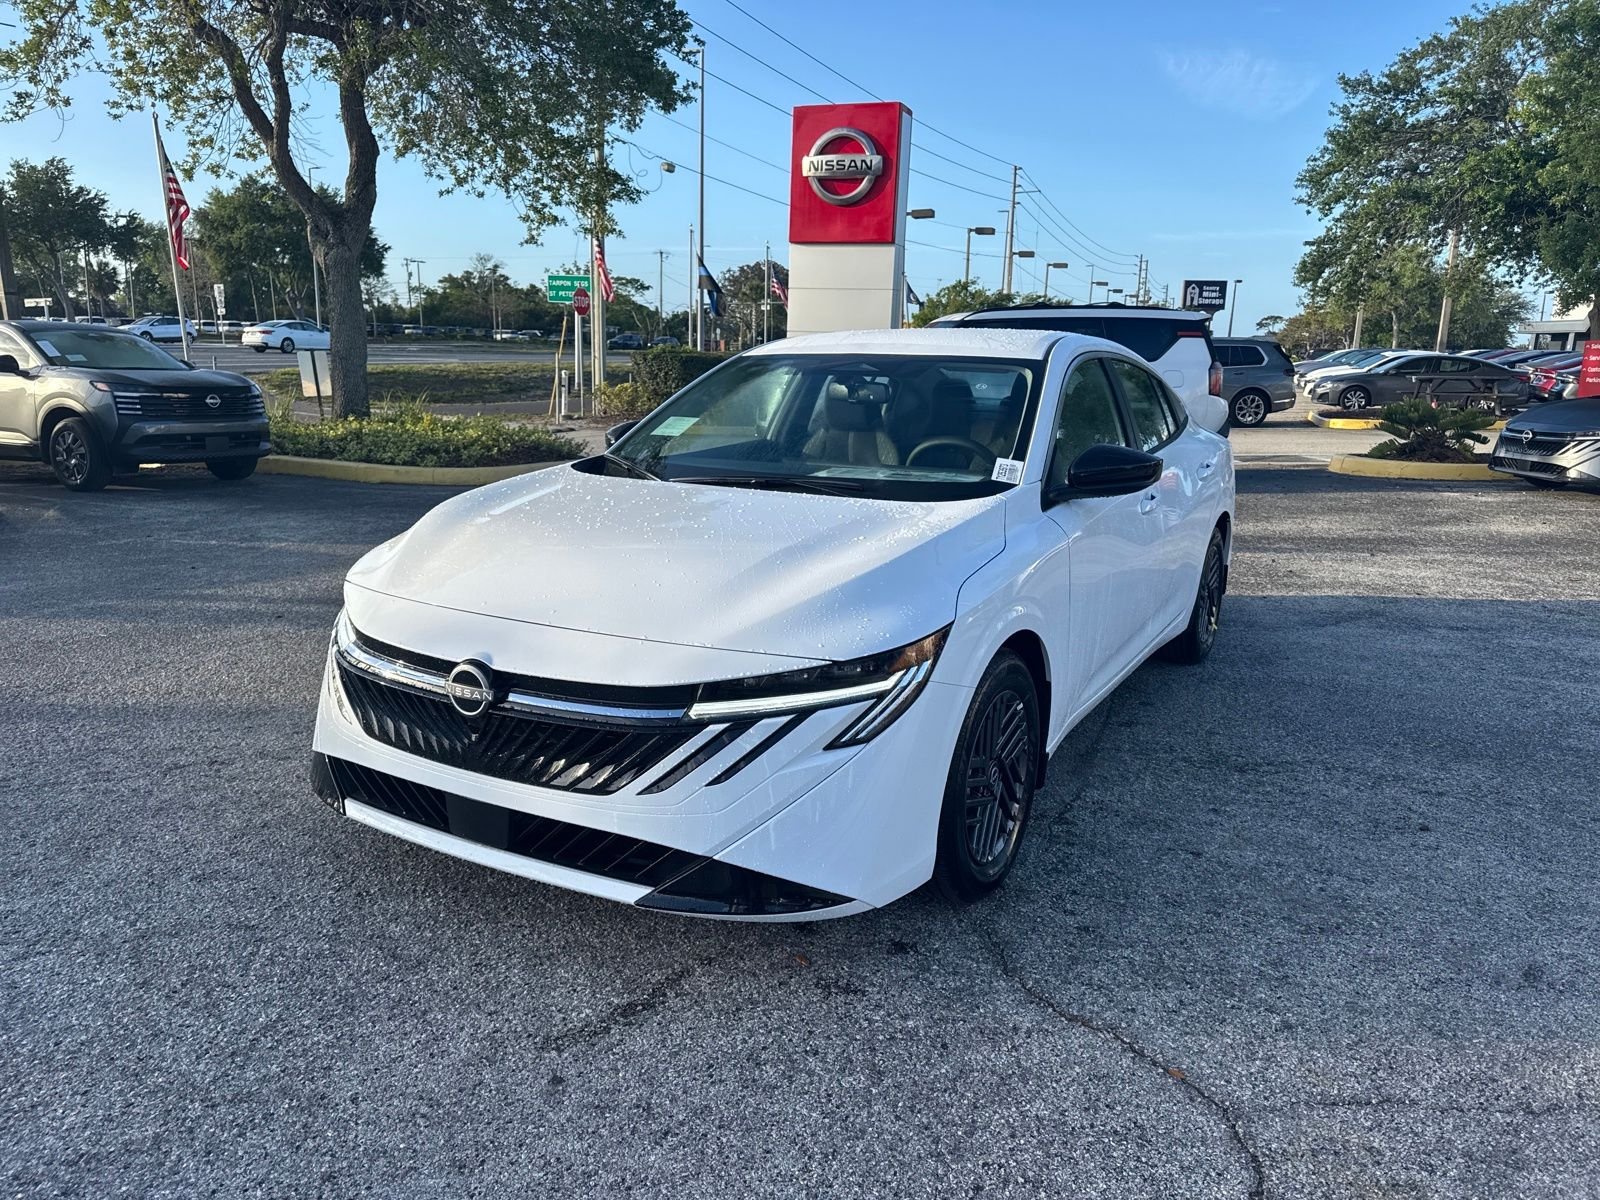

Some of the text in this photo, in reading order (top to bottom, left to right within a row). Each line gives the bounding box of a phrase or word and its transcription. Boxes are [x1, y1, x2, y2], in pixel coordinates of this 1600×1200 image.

[808, 159, 873, 172] NISSAN
[574, 296, 590, 308] STOP
[1198, 297, 1224, 305] Storage
[445, 682, 492, 701] NISSAN
